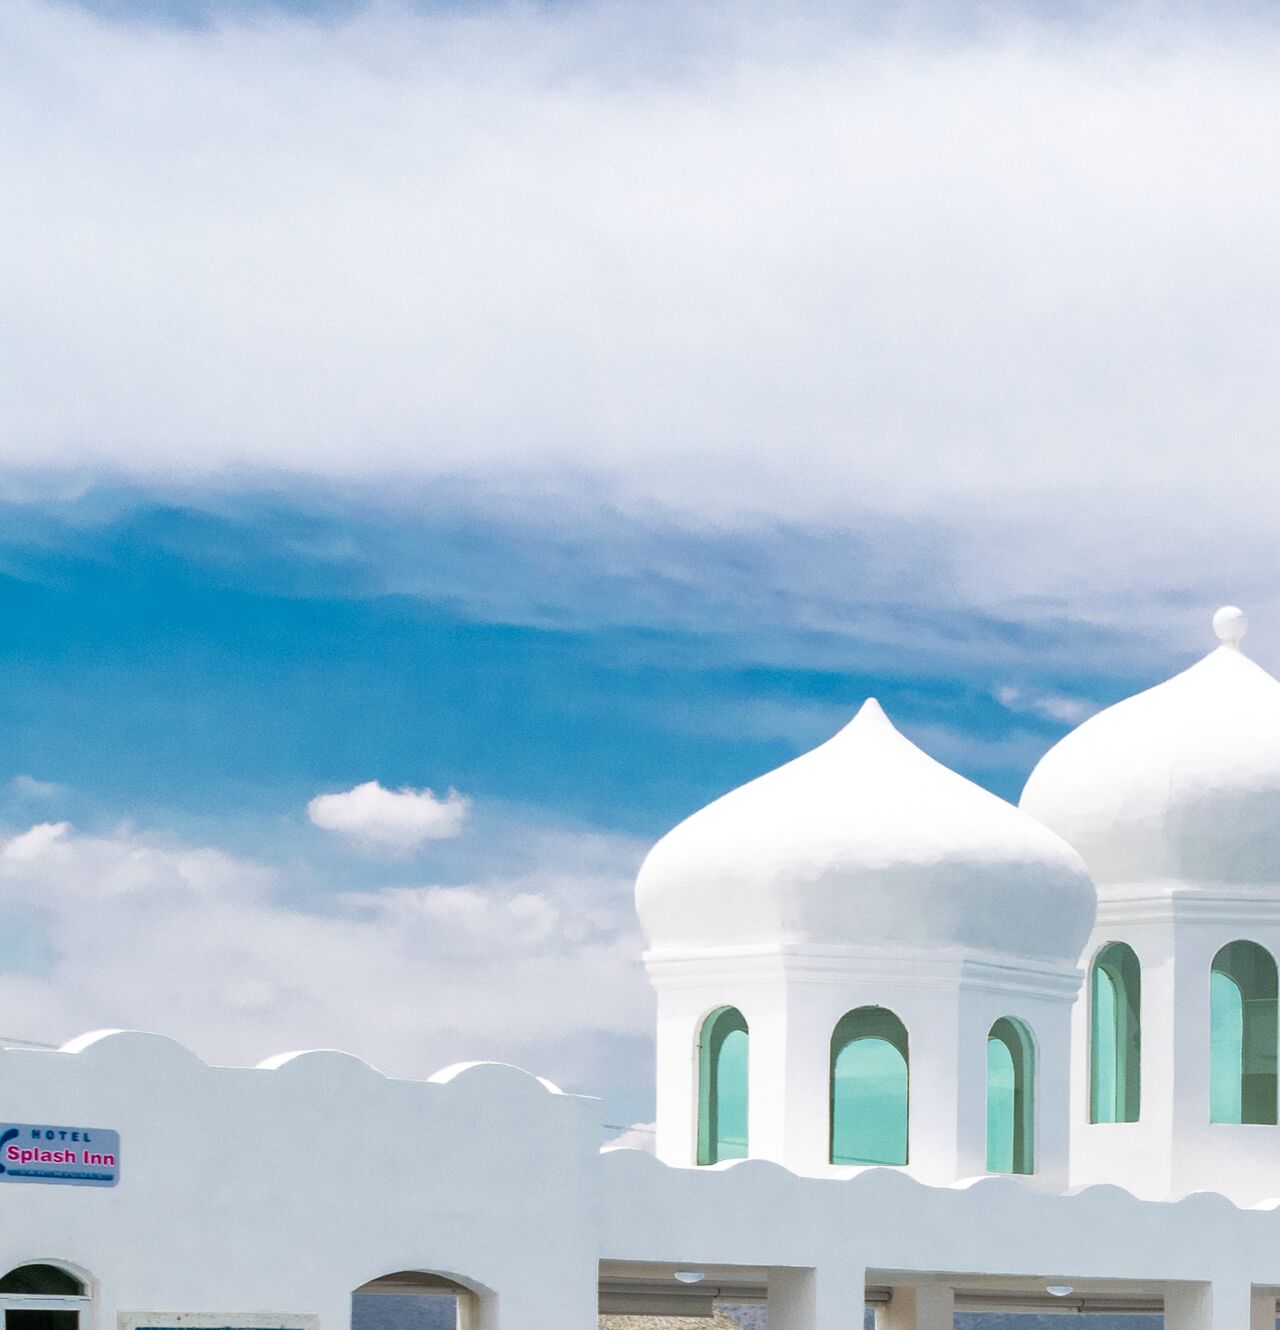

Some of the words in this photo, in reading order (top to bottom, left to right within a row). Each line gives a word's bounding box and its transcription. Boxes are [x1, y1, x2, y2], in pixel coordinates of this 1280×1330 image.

[31, 1129, 91, 1142] HOTEL
[7, 1145, 77, 1164] Splash
[83, 1150, 115, 1166] Inn
